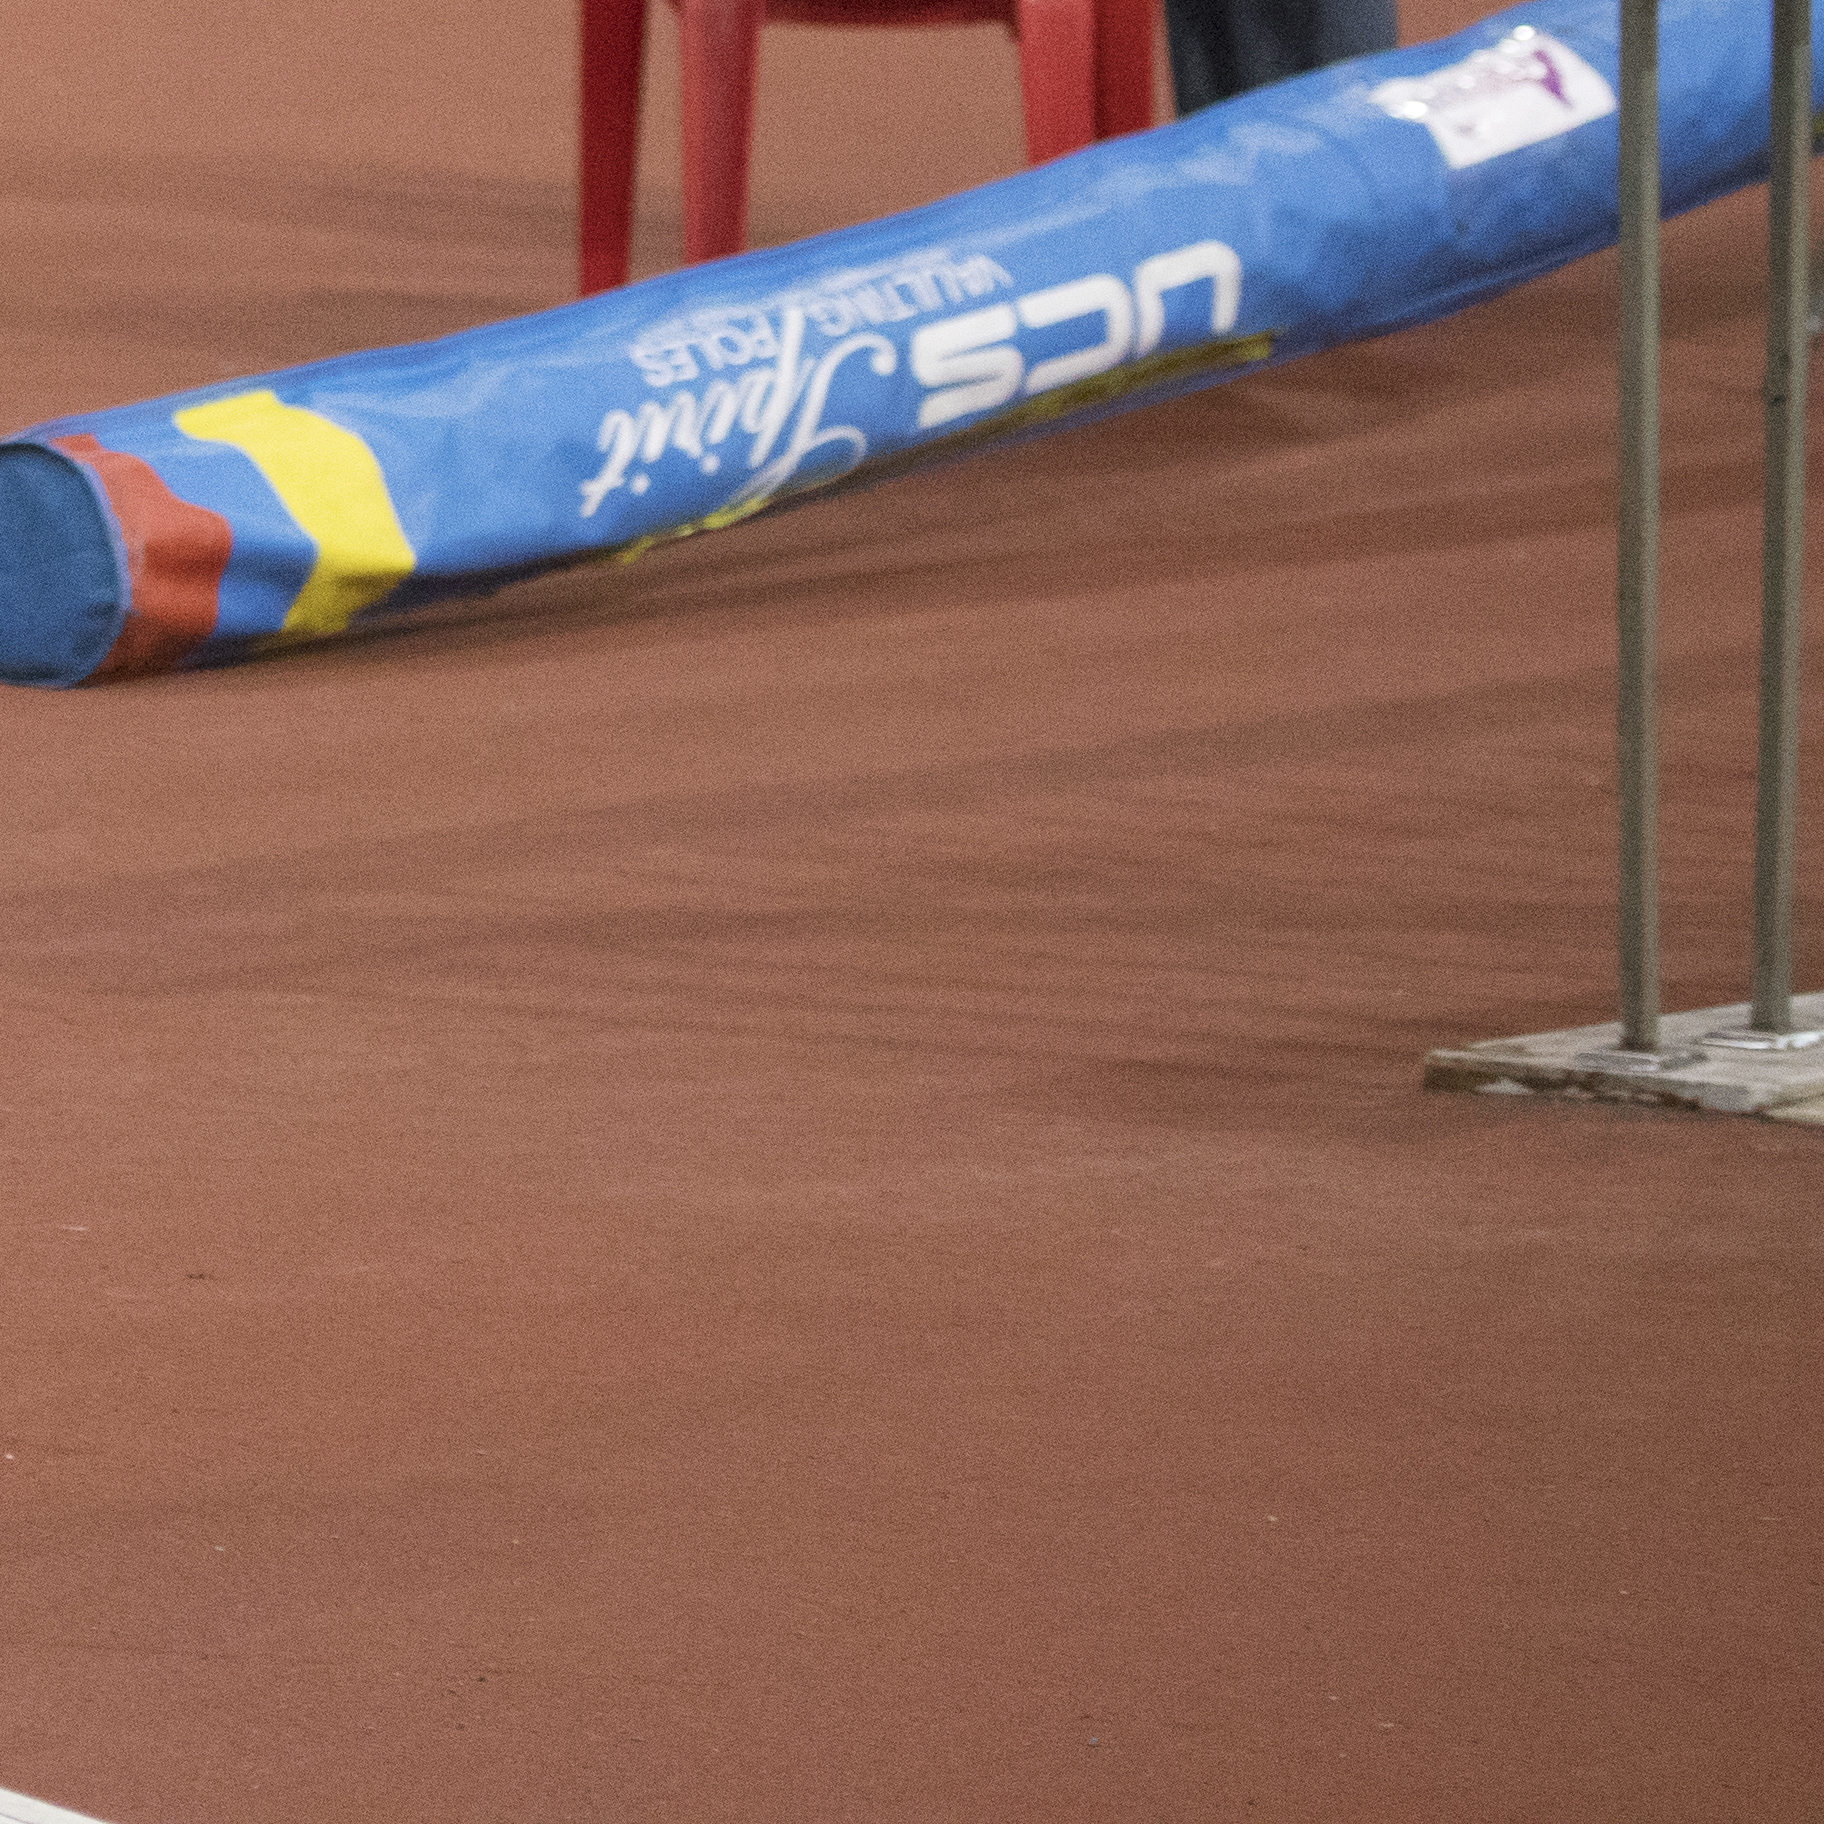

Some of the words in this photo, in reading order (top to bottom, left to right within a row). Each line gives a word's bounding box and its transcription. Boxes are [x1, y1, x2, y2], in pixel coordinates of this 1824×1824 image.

[629, 309, 780, 387] POLES
[807, 255, 1014, 337] VAULTING
[911, 239, 1243, 430] UCS
[581, 306, 898, 518] Spirit
